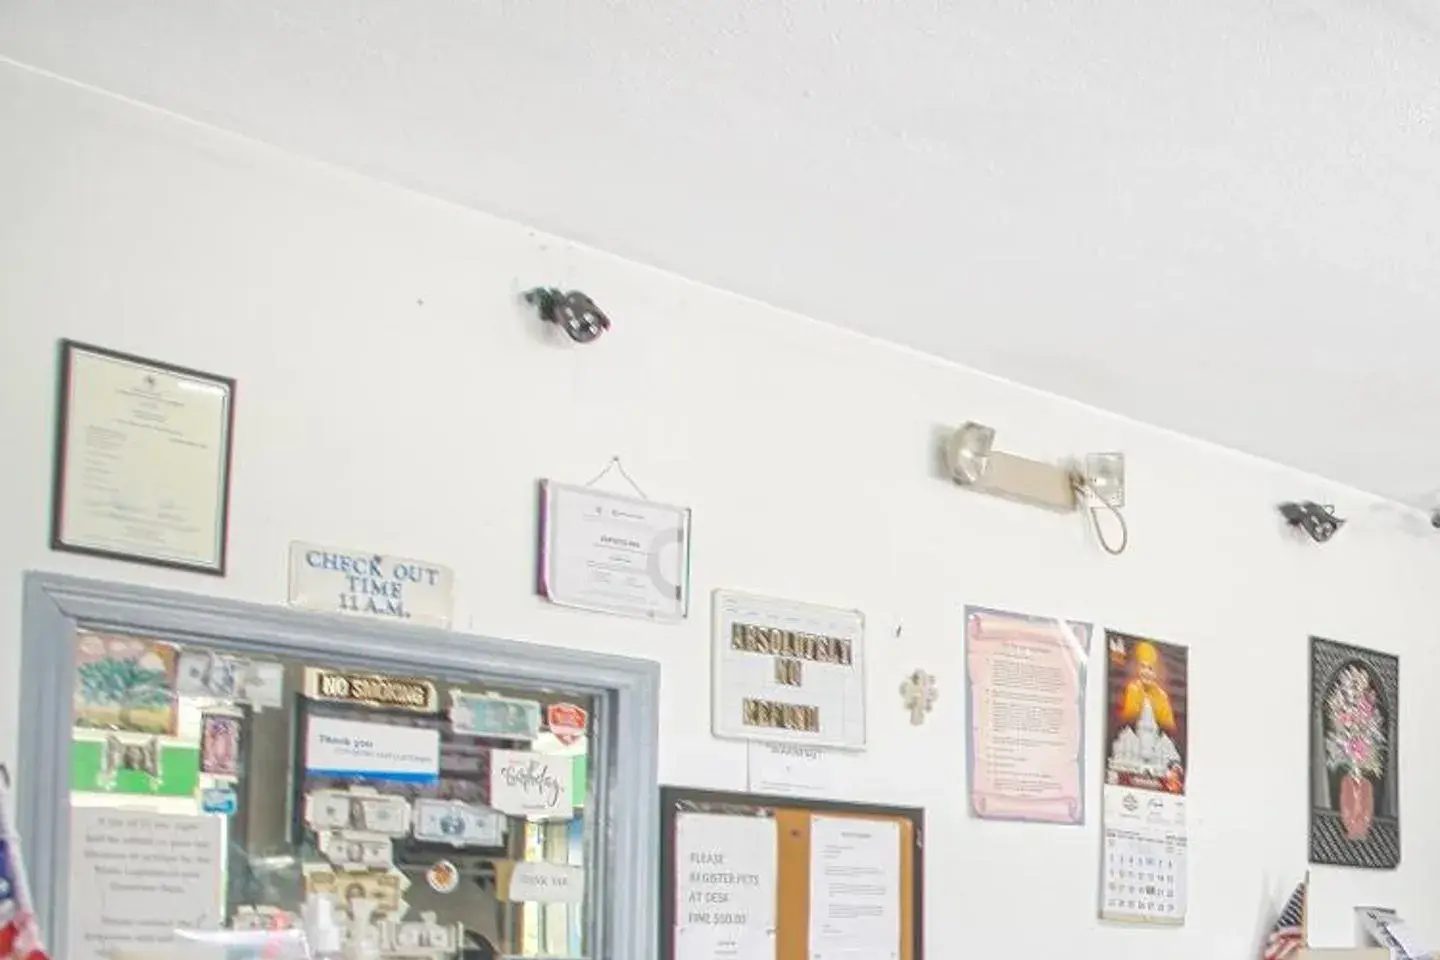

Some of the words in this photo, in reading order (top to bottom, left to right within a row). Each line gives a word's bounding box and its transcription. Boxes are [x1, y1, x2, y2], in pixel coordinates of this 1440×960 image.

[306, 550, 383, 578] CHECK
[393, 564, 439, 585] OUT
[346, 574, 402, 598] TIME
[322, 674, 350, 696] NO
[690, 851, 723, 865] PLEASE
